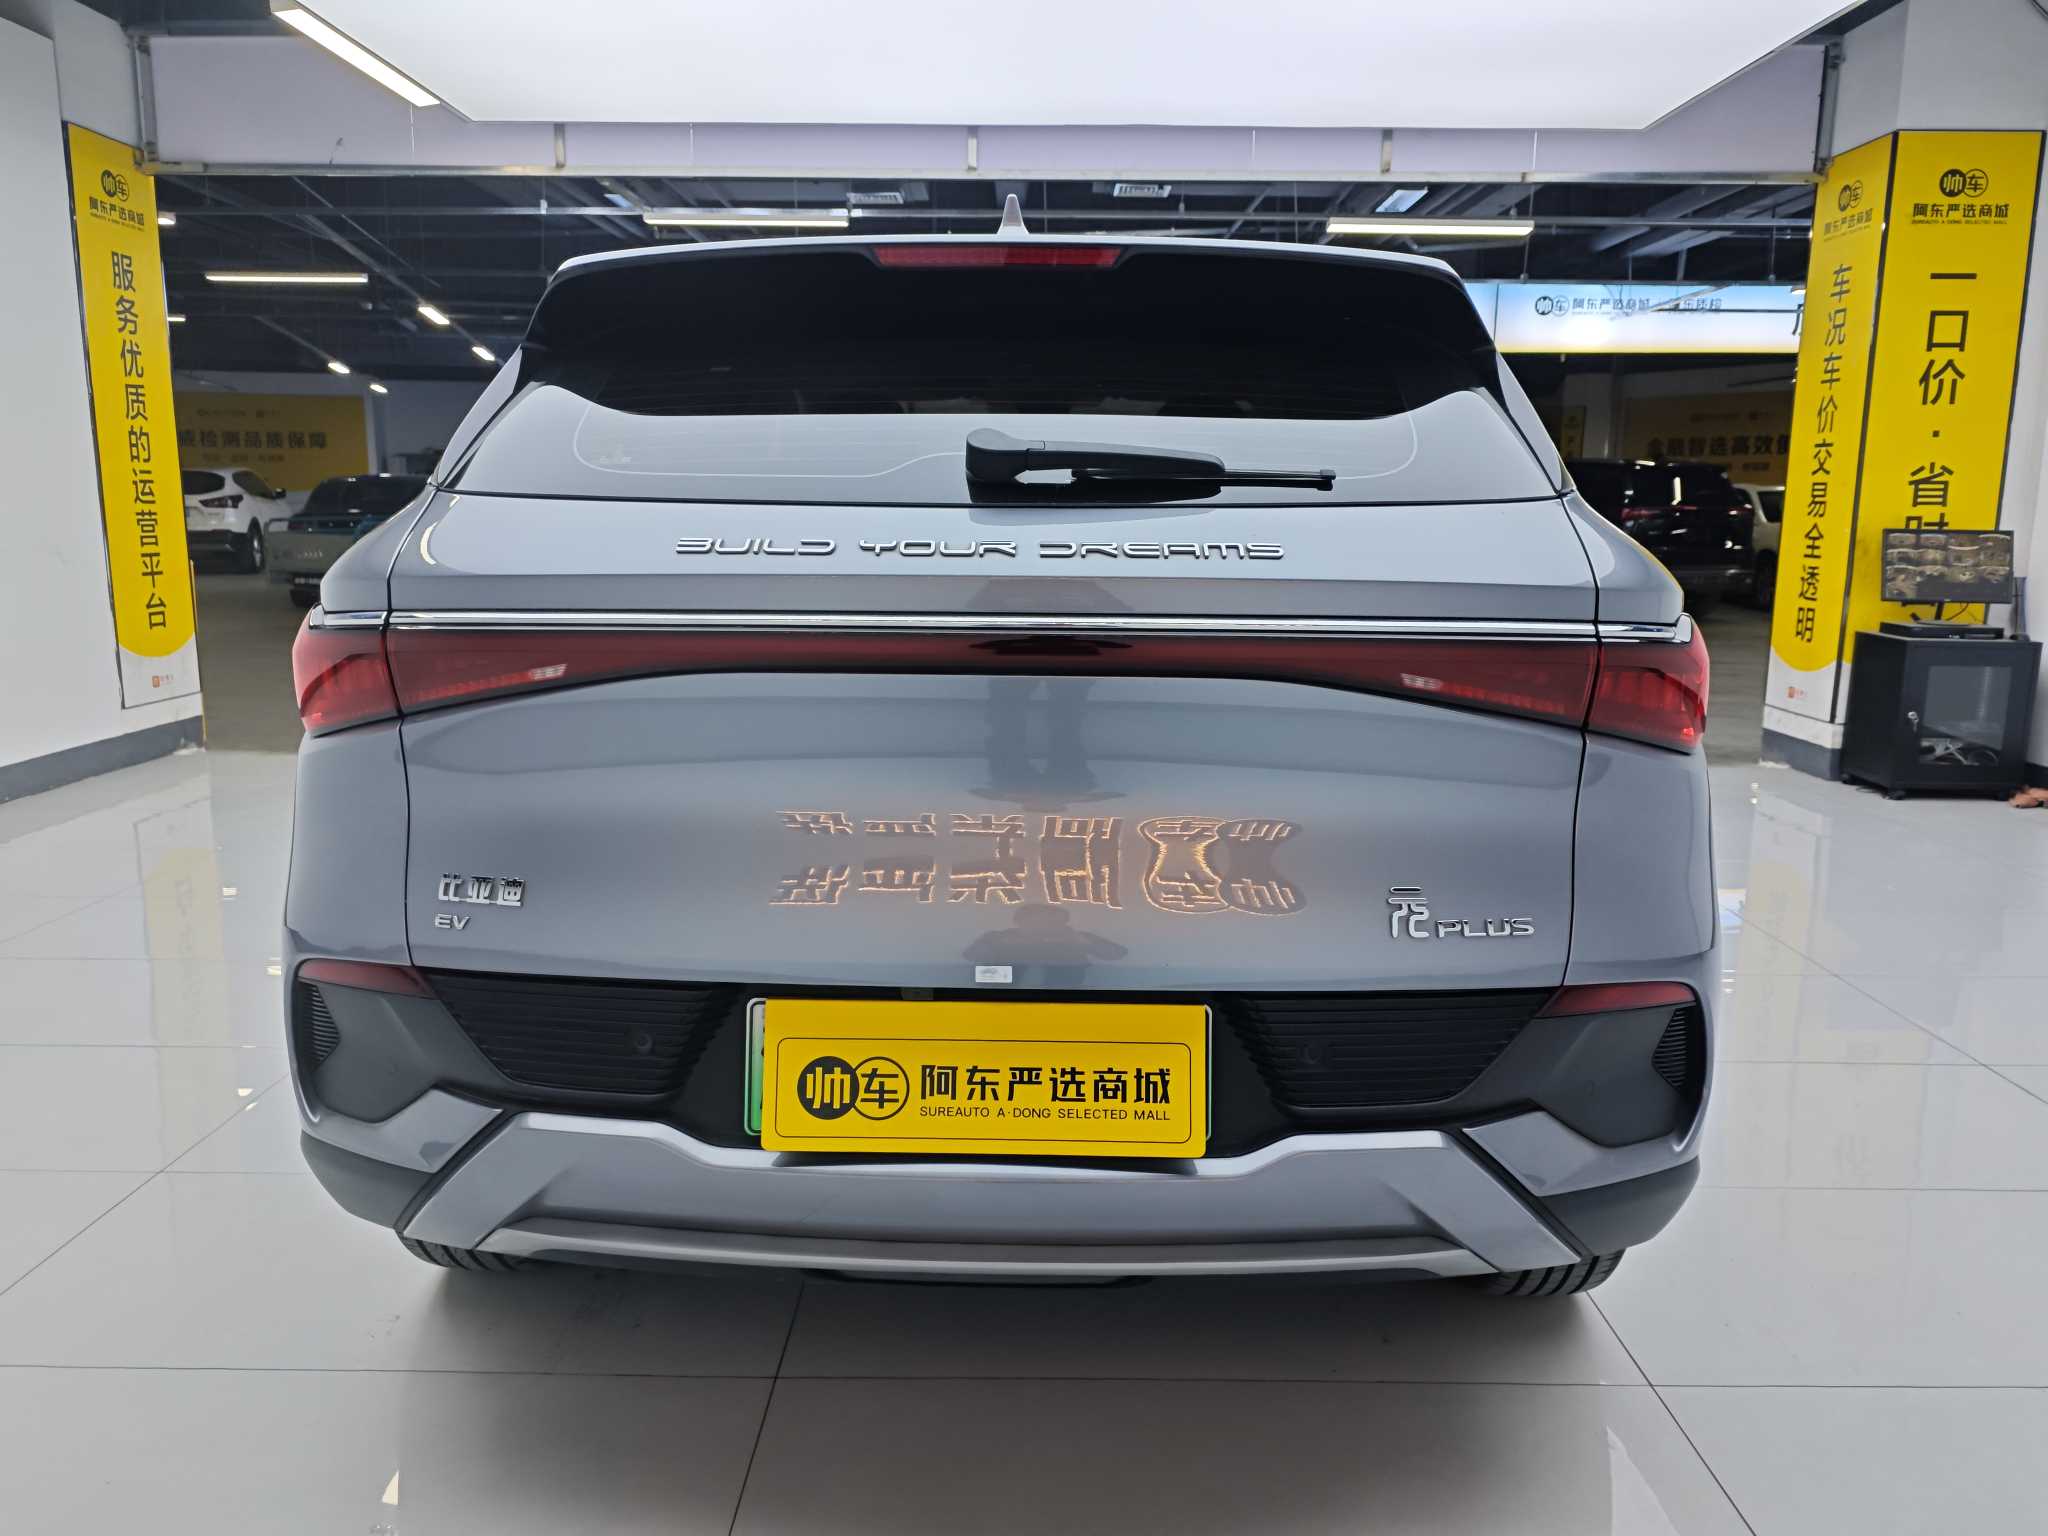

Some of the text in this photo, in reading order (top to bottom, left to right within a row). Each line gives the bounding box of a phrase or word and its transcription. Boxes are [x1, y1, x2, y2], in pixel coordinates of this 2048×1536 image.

[1941, 171, 1987, 195] 帅车
[1912, 203, 2010, 218] 阿东严选商城
[111, 251, 168, 630] 服务优质的运营平台
[1795, 264, 1852, 643] 车况车价交易全透明
[675, 536, 1285, 560] BUILD YOUR DREAMS
[437, 873, 525, 907] 比亚迪
[434, 913, 471, 930] EV
[1387, 886, 1536, 939] 元 PLUS
[802, 1061, 1171, 1114] 帅车 阿东严选商城
[919, 1105, 990, 1118] SUREAUTO
[1057, 1108, 1128, 1121] SELECTED
[1133, 1109, 1171, 1122] MALL
